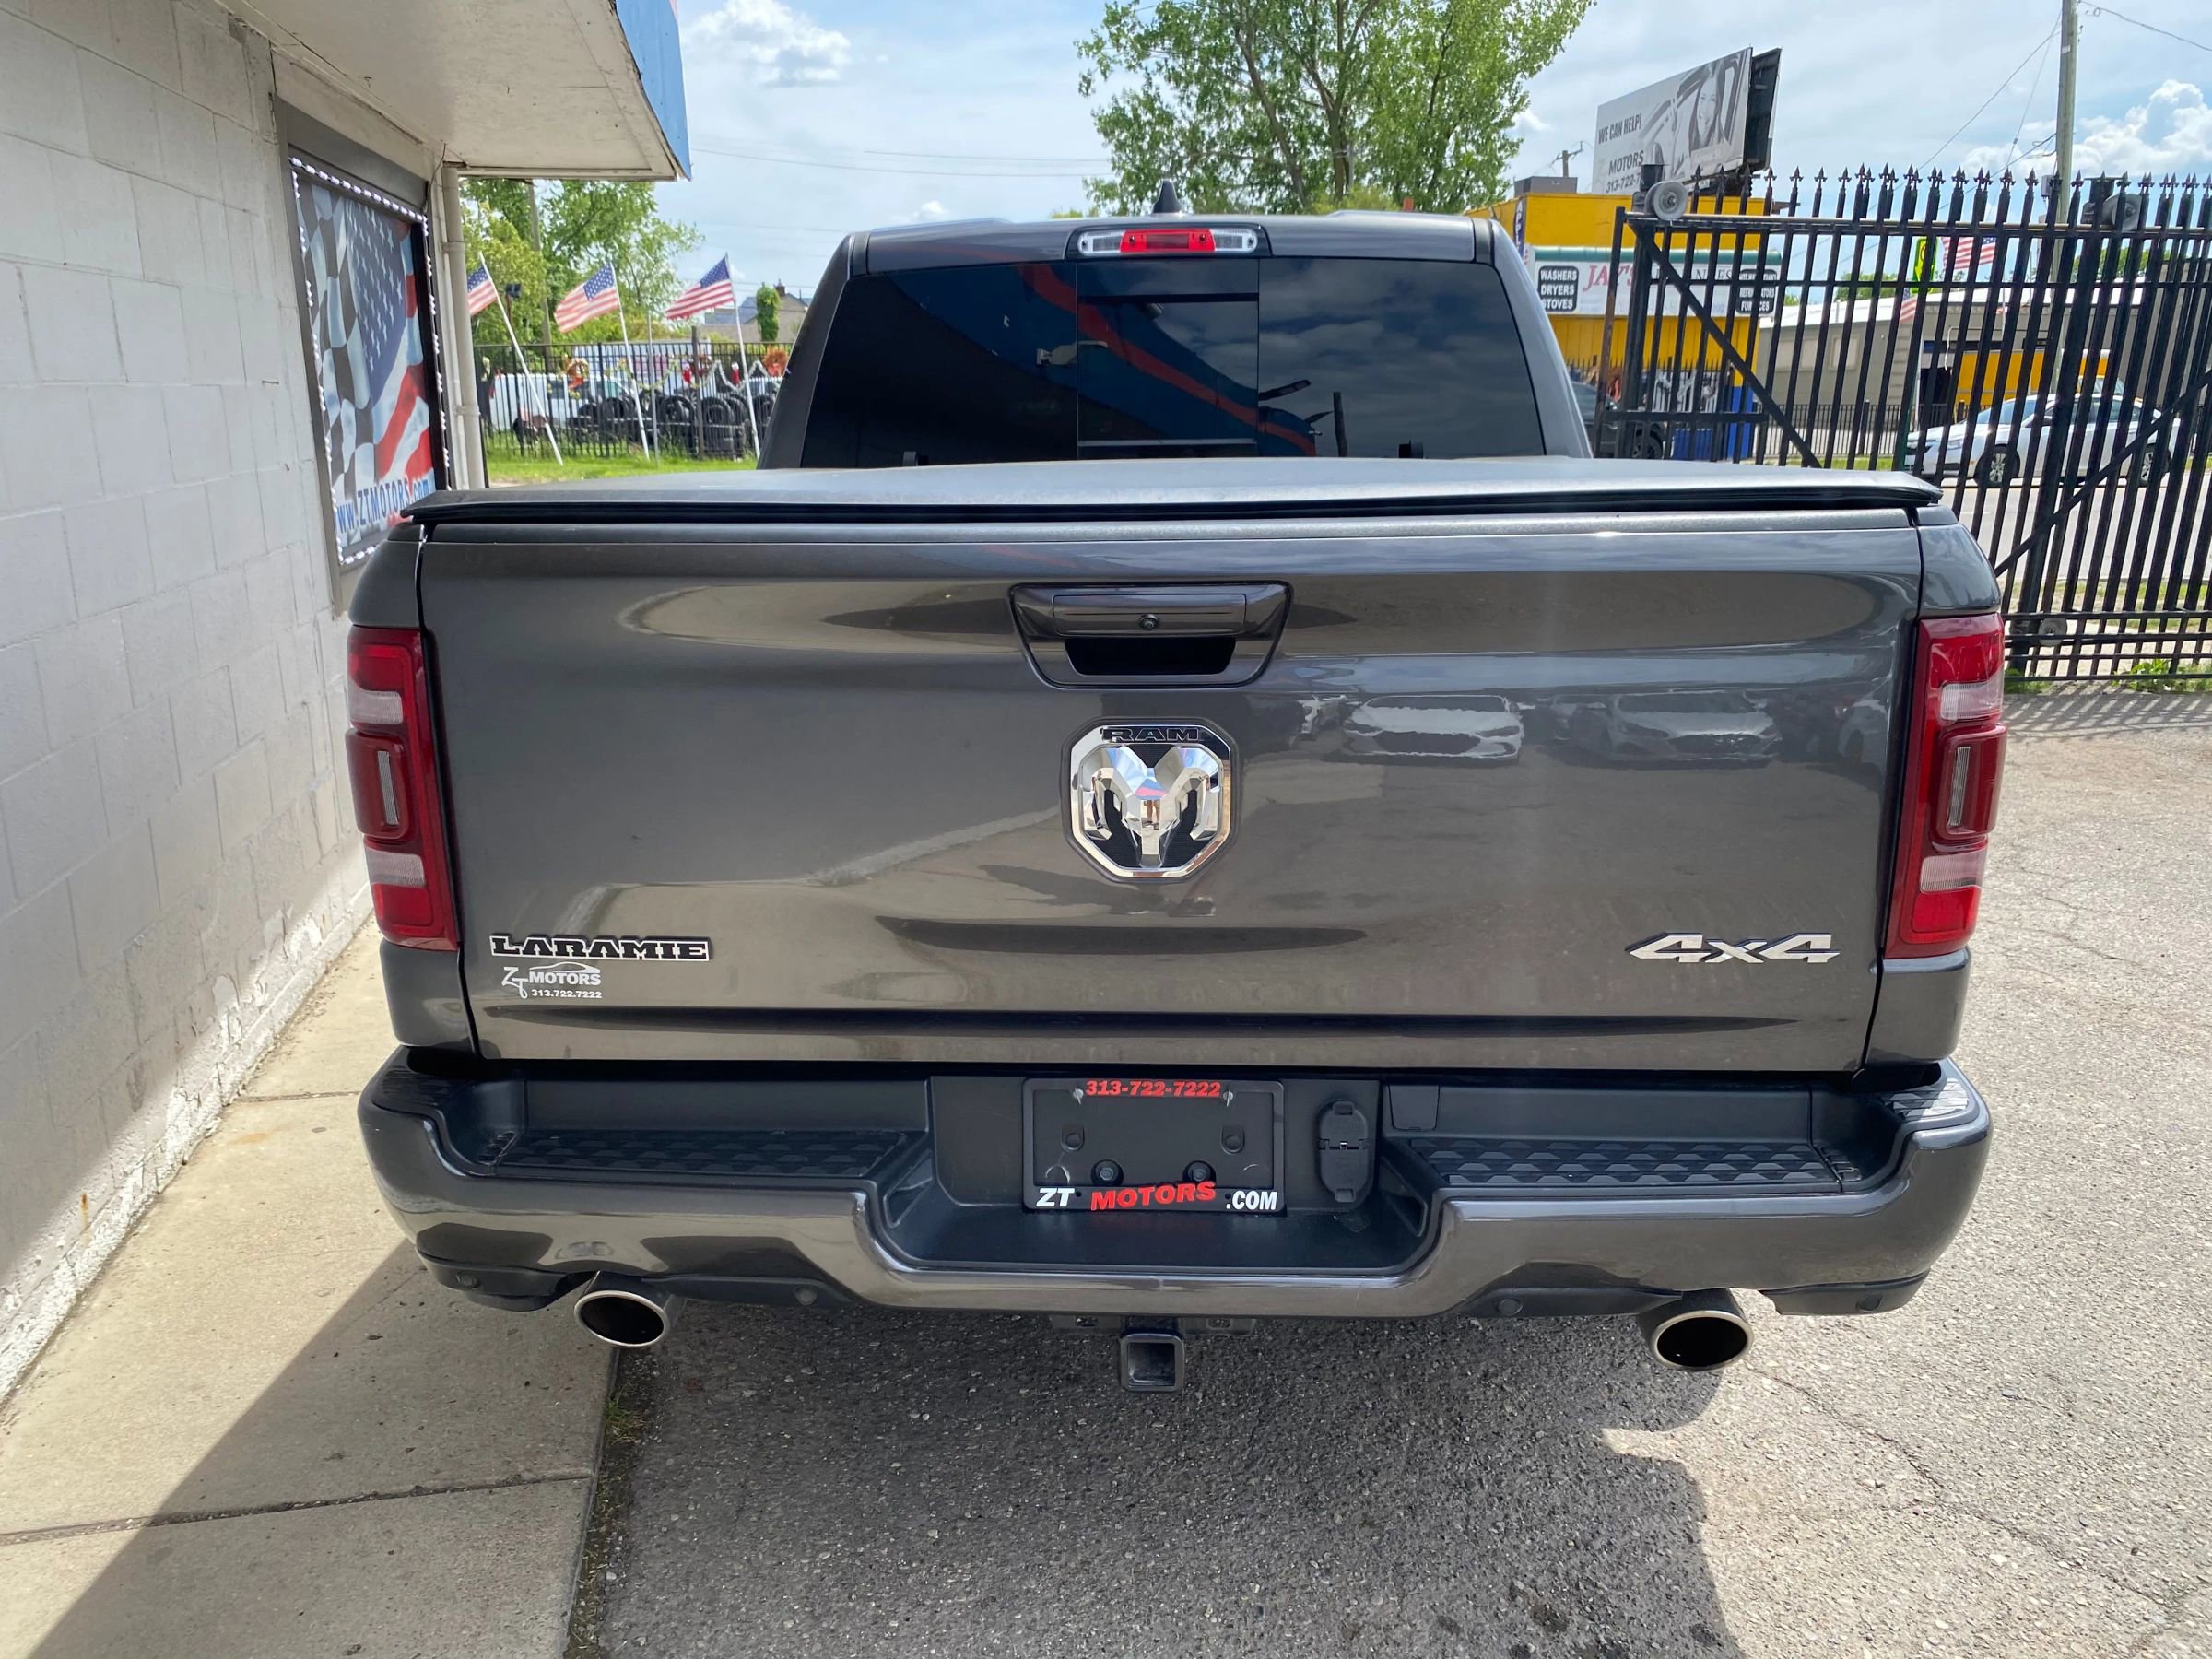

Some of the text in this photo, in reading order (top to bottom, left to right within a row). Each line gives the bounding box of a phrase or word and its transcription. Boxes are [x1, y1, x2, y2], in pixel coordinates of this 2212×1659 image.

[1598, 112, 1642, 145] WE CAN HELP!
[1607, 149, 1644, 176] MOTORS
[1606, 172, 1642, 194] 313-722-7
[1540, 269, 1577, 281] WASHERS
[1540, 284, 1575, 296] DRYERS
[1541, 298, 1573, 310] STOVES
[1741, 300, 1770, 312] FURCES
[1101, 726, 1199, 744] RAM
[488, 935, 711, 962] LARAMIE
[528, 971, 602, 986] MOTORS
[531, 988, 603, 999] 313.722.7222
[1085, 1079, 1221, 1098] 313-722-7222
[1035, 1181, 1278, 1211] ZT MOTORS .COM
